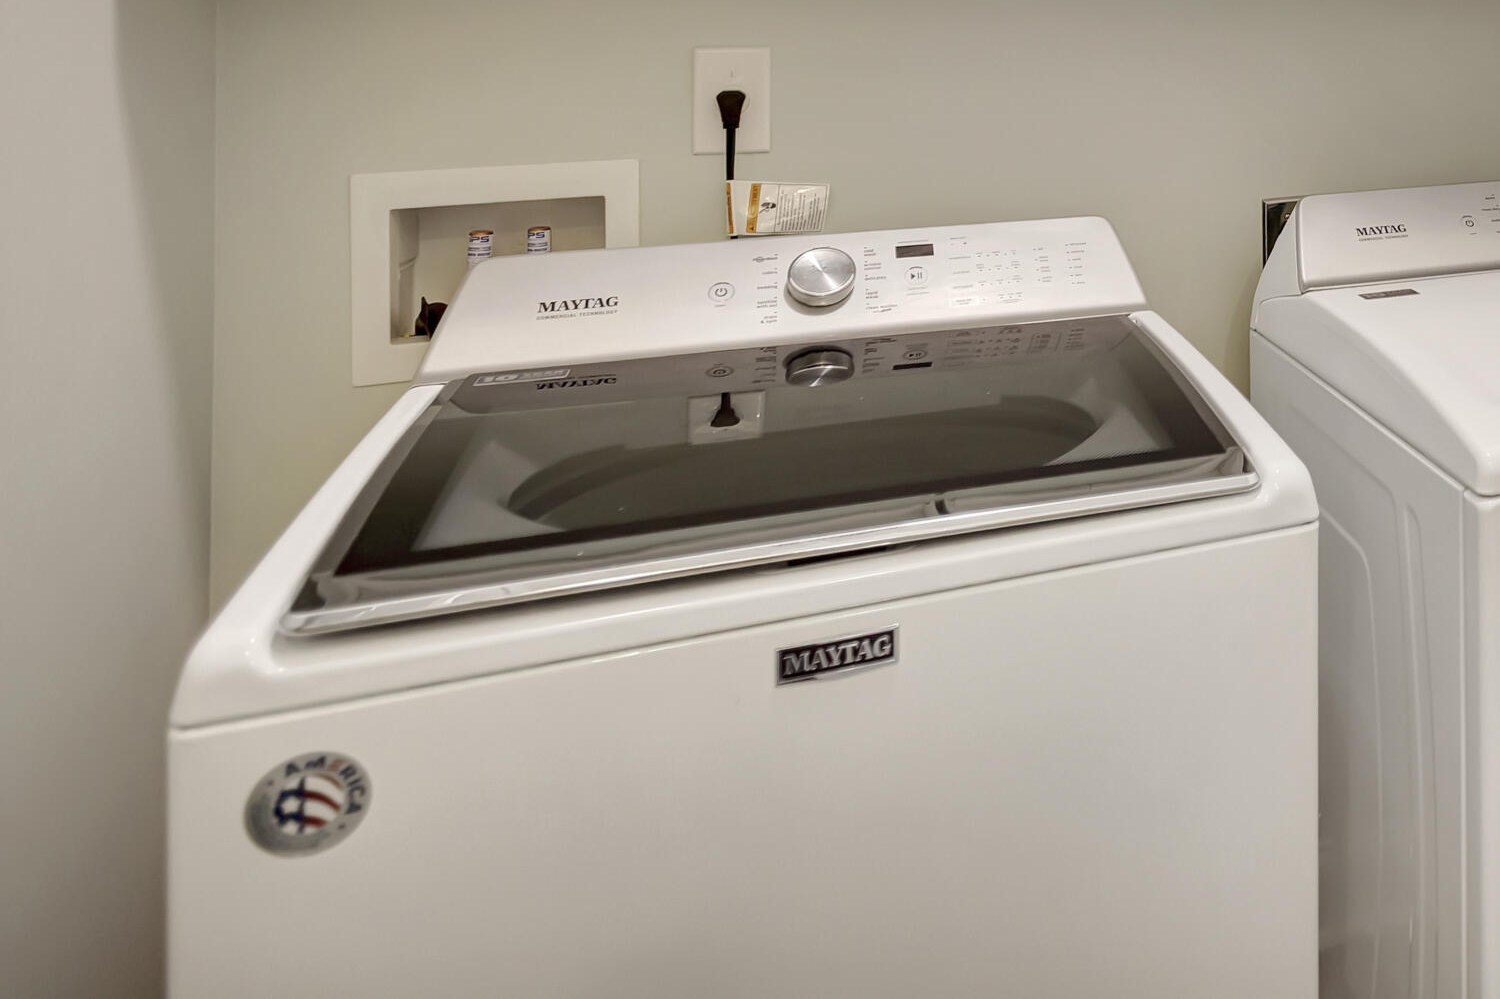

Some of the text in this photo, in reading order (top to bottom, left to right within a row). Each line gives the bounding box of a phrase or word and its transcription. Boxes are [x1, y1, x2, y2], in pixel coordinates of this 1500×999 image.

[1356, 224, 1407, 237] MAYTAG
[537, 296, 619, 313] MAYTAG
[783, 634, 892, 676] MAYTAG
[284, 756, 366, 815] AMERICA
